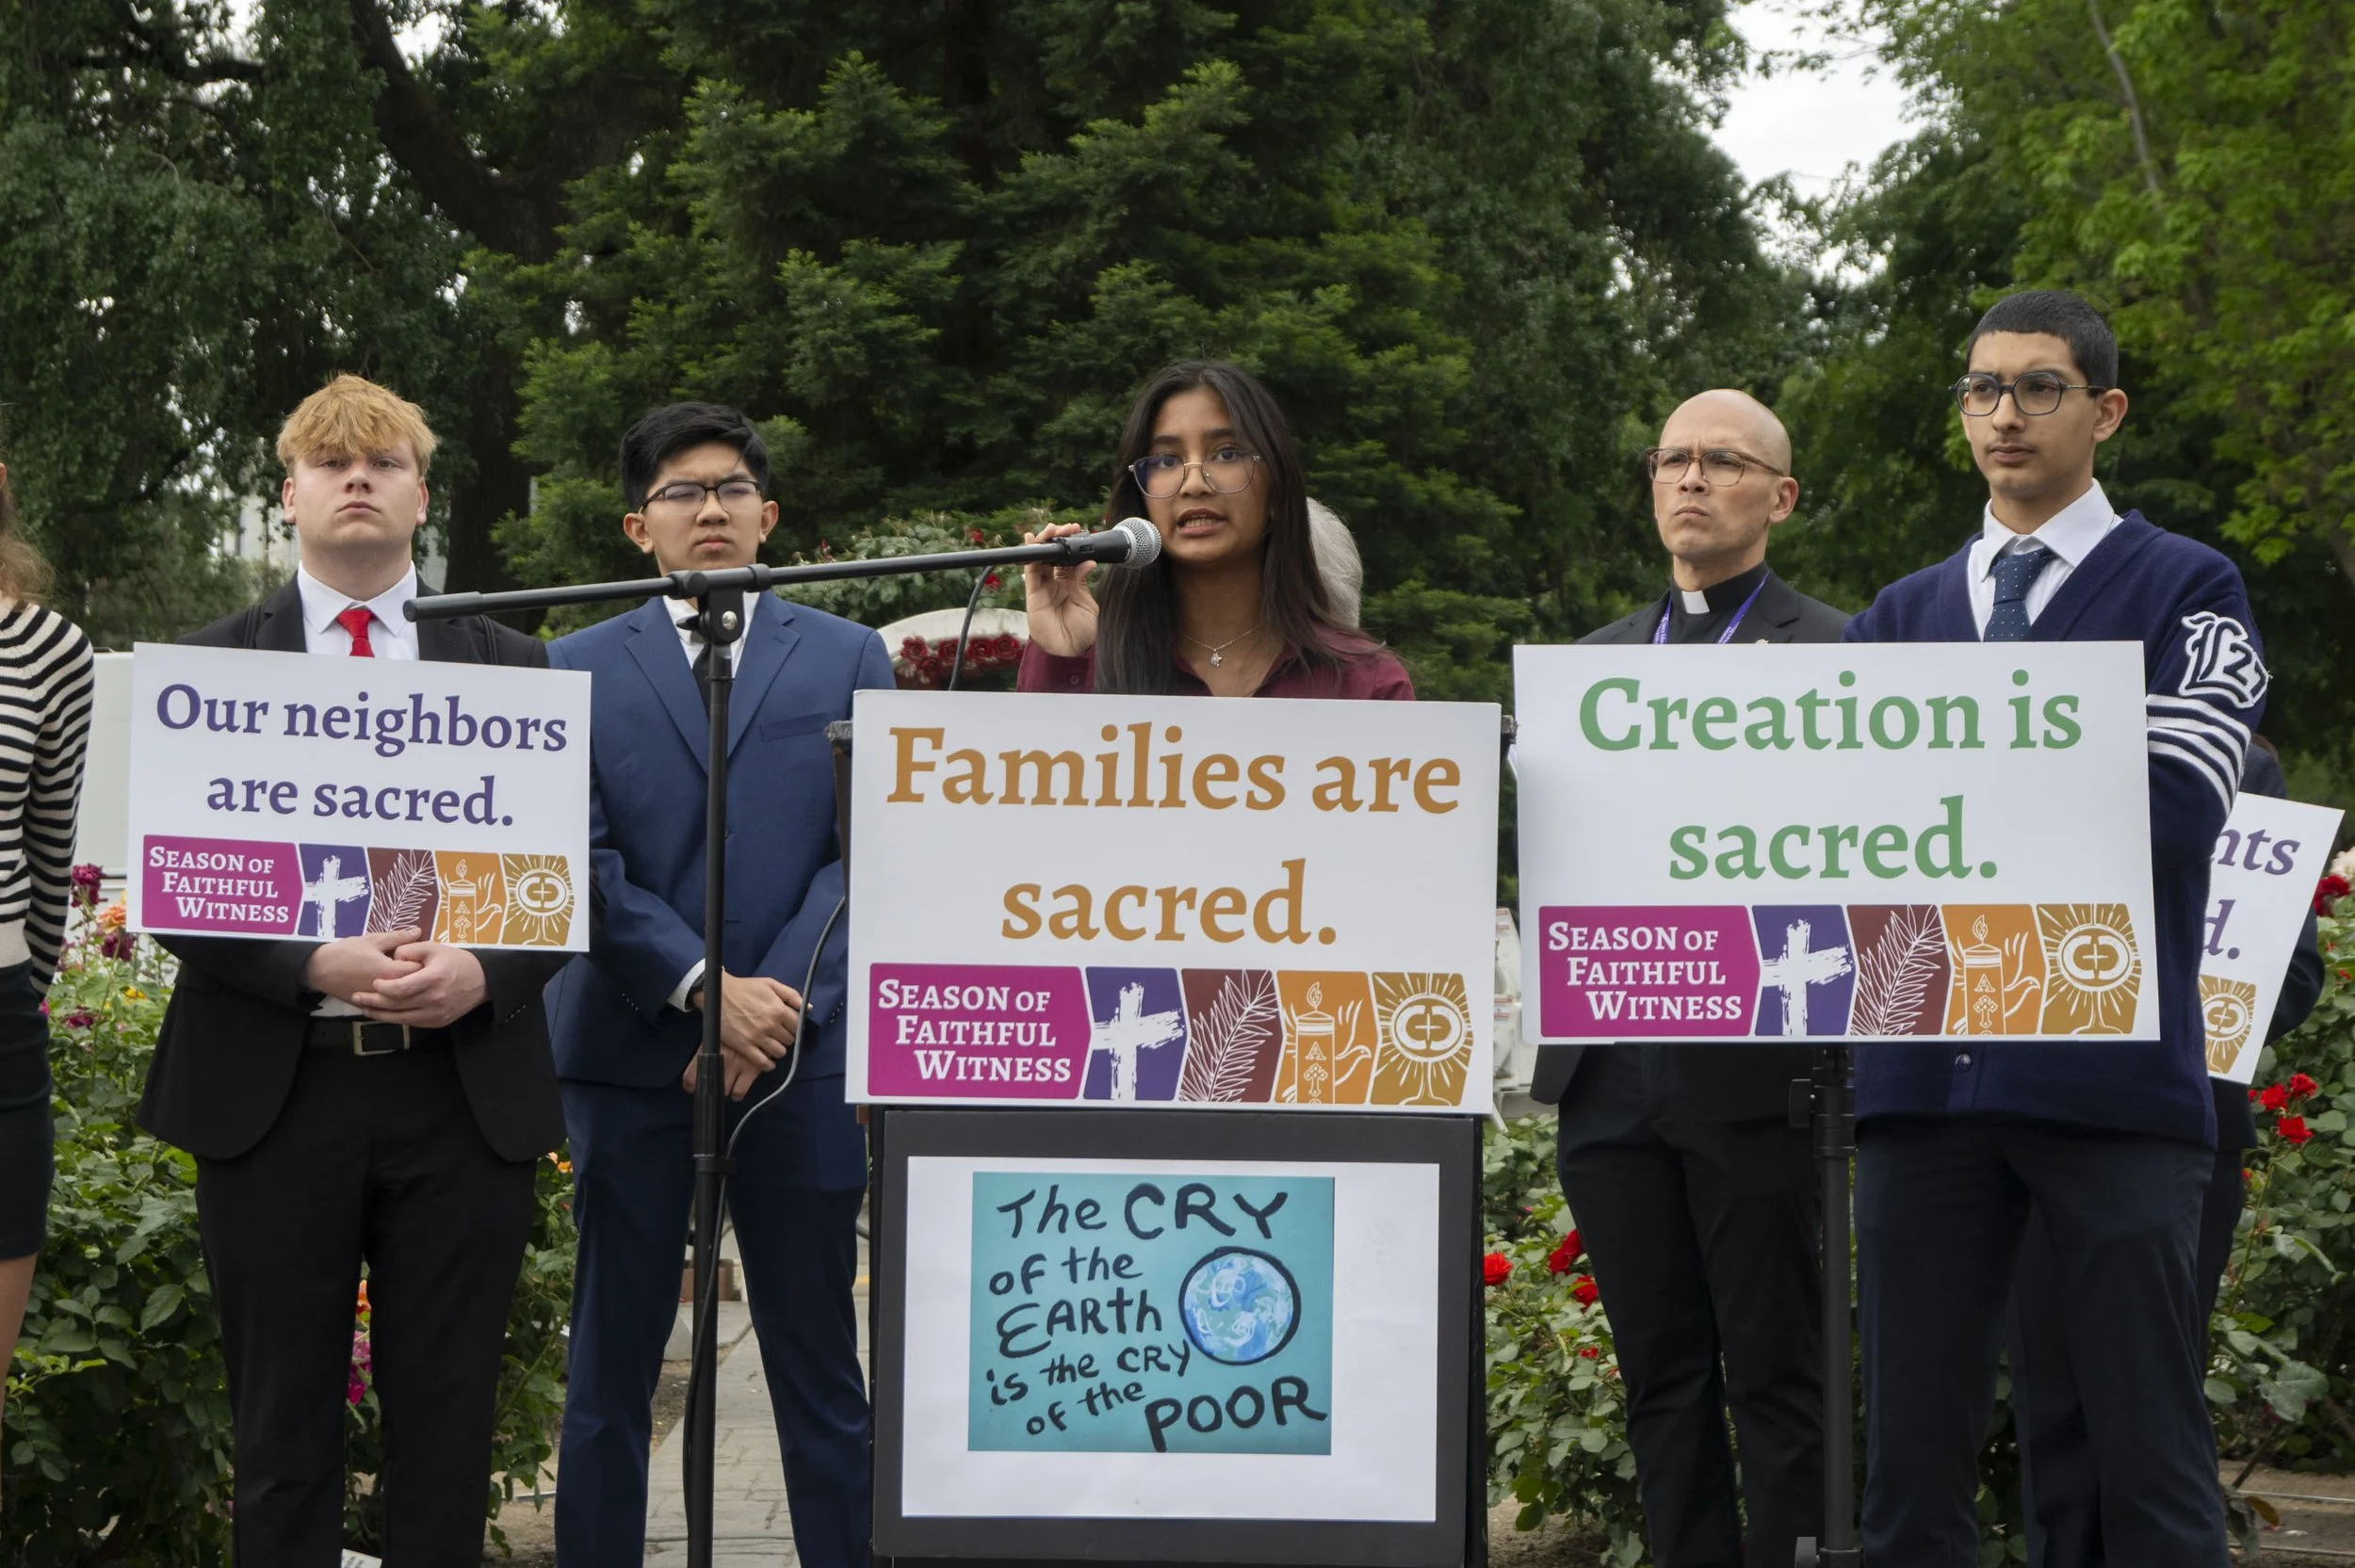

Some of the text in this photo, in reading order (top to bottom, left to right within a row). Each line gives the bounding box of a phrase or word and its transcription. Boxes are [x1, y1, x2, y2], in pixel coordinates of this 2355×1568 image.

[157, 684, 566, 757] Our neighbors
[1581, 670, 2081, 751] Creation is
[887, 721, 1460, 814] Families are
[207, 775, 512, 826] are sacred.
[1670, 795, 1997, 880] sacred.
[149, 846, 274, 874] SEASON OF
[162, 871, 279, 898] FAITHFUL
[1002, 858, 1336, 945] sacred.
[175, 896, 289, 923] WITNESS
[1550, 921, 1718, 951] SEASON OF
[1567, 957, 1726, 986] FAITHFUL
[879, 978, 1050, 1012] SEASON OF
[1586, 991, 1741, 1021] WITNESS
[896, 1014, 1056, 1047] FAITHFUL
[918, 1050, 1071, 1083] WITNESS
[996, 1182, 1289, 1240] The CRY
[1061, 1246, 1145, 1285] the
[985, 1339, 1191, 1406] is the CRY
[1077, 1381, 1146, 1416] the
[1145, 1376, 1328, 1453] POOR
